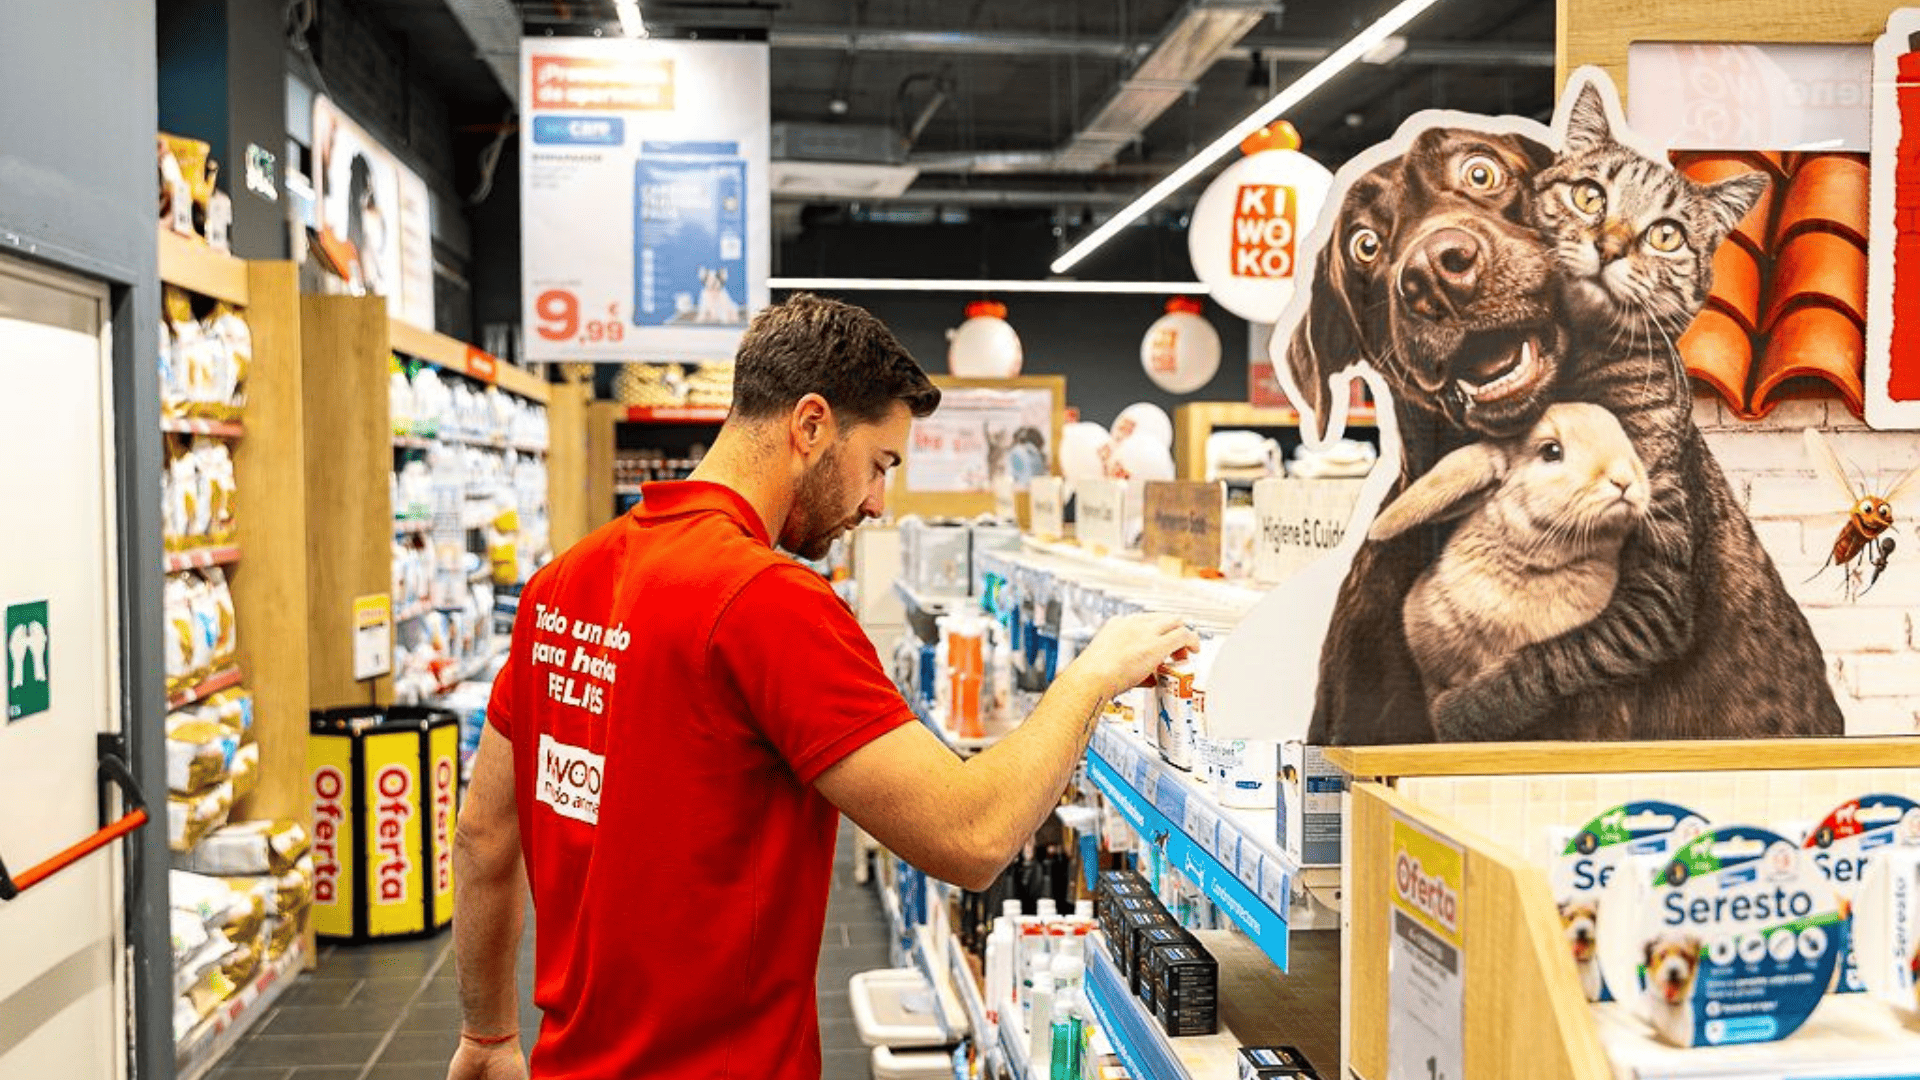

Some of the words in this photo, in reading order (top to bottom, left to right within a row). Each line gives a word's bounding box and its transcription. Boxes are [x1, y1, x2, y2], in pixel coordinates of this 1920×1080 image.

[1241, 187, 1287, 217] KI
[1237, 217, 1292, 248] WO
[1237, 248, 1291, 277] KO
[1303, 517, 1311, 547] &
[571, 618, 603, 645] un
[315, 768, 343, 902] Oferta
[378, 768, 410, 901] Oferta
[436, 760, 451, 891] Oferta
[1396, 854, 1455, 924] Oferta
[1663, 887, 1812, 925] Seresto
